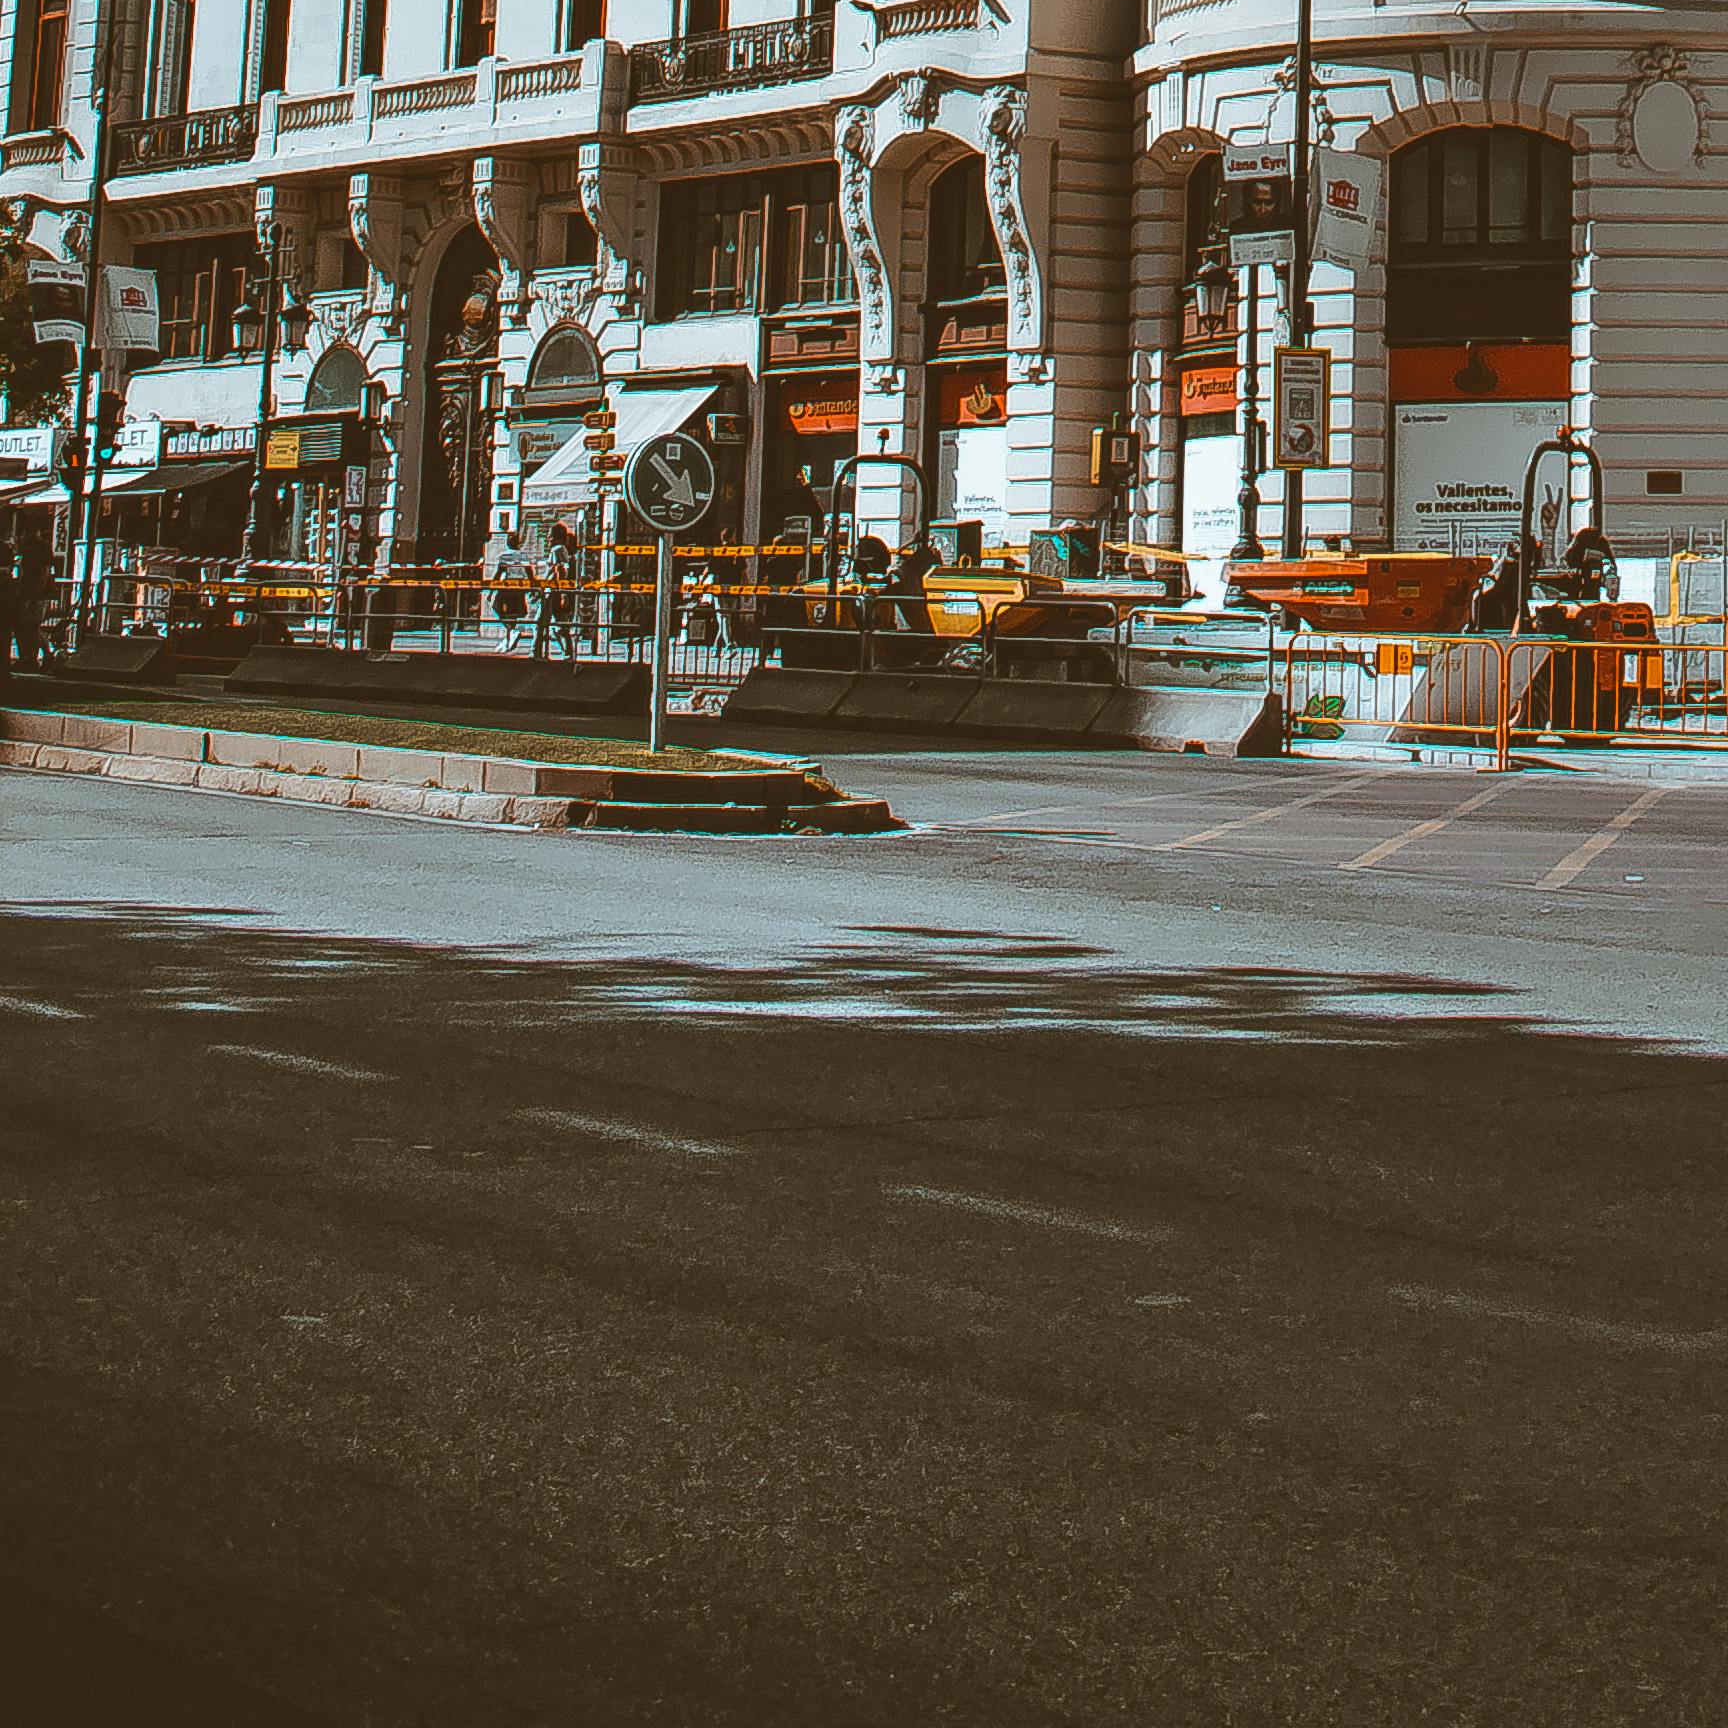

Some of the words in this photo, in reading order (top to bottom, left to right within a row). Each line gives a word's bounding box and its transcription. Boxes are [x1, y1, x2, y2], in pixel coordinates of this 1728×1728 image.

[1436, 482, 1514, 500] Valientes,
[1415, 501, 1433, 514] os
[1434, 497, 1523, 514] necesitamo
